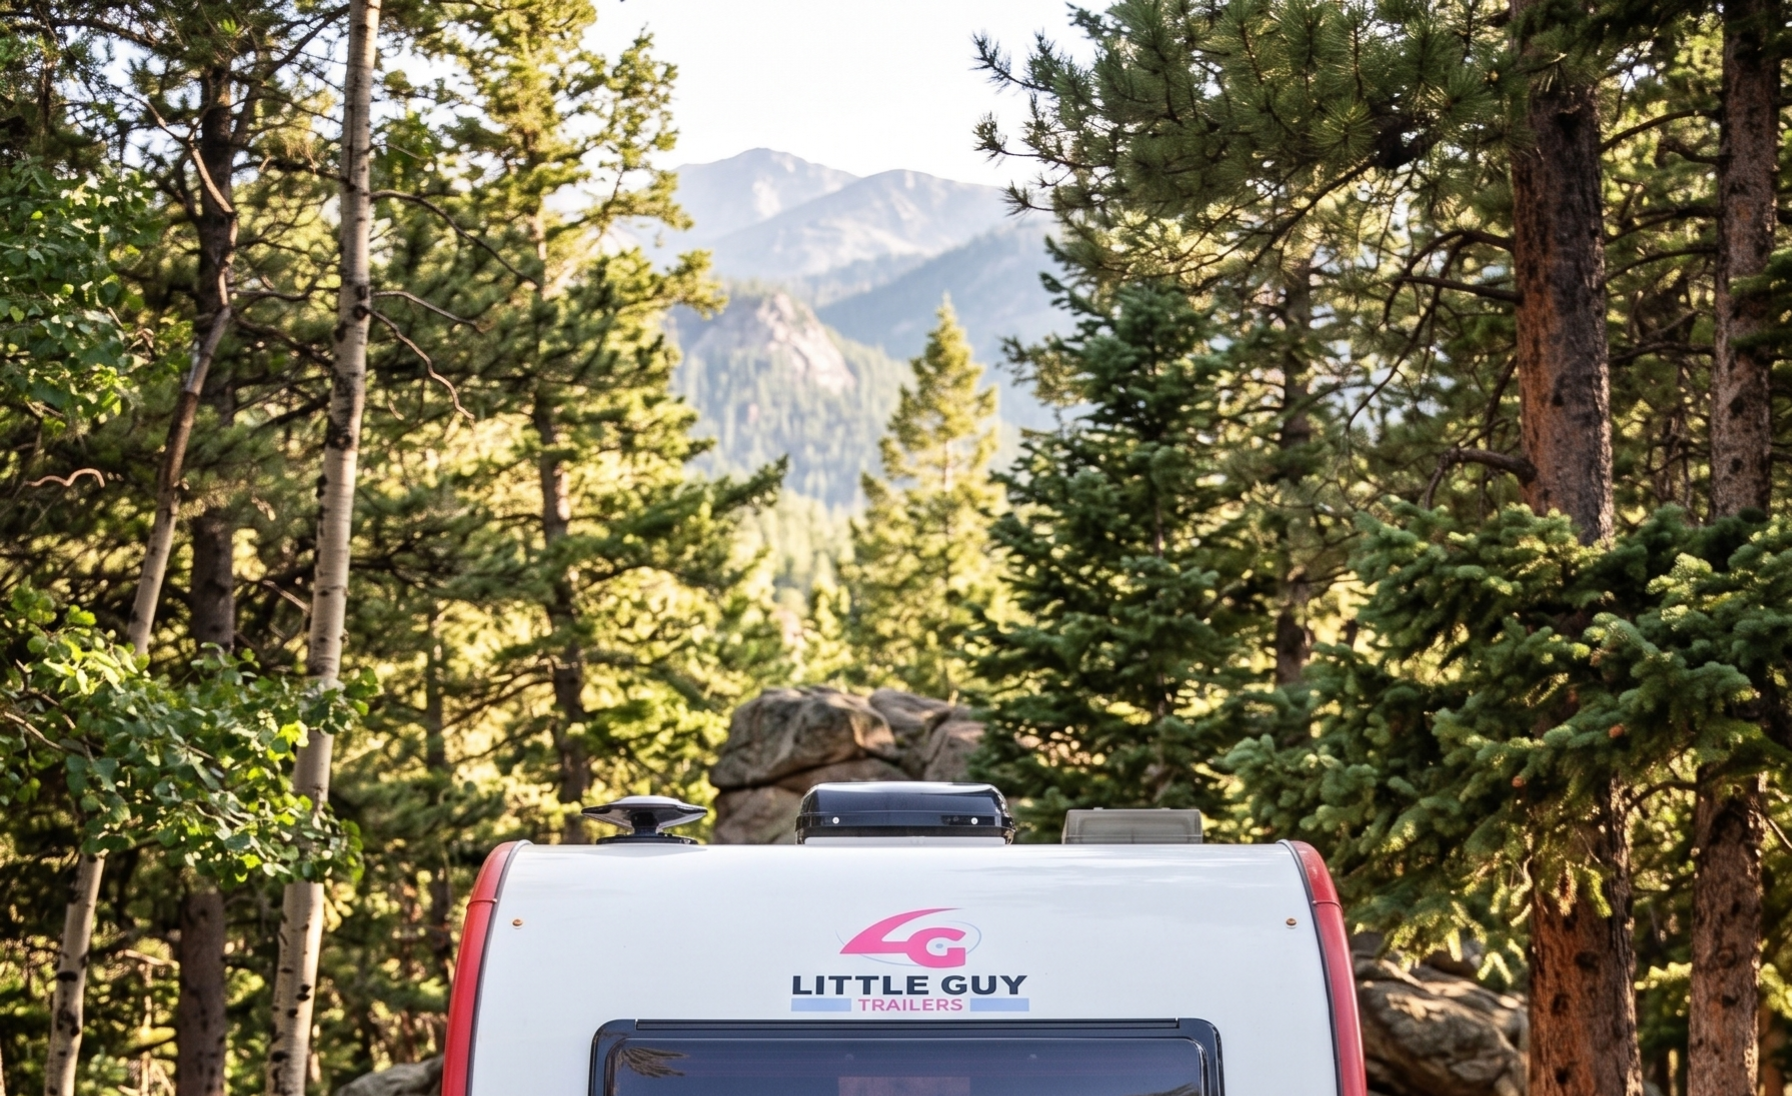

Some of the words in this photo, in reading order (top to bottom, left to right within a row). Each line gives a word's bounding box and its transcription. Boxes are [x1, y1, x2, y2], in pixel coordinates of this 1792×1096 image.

[792, 975, 929, 996] LITTLE
[941, 975, 1028, 996] GUY
[858, 998, 964, 1012] TRAILERS
